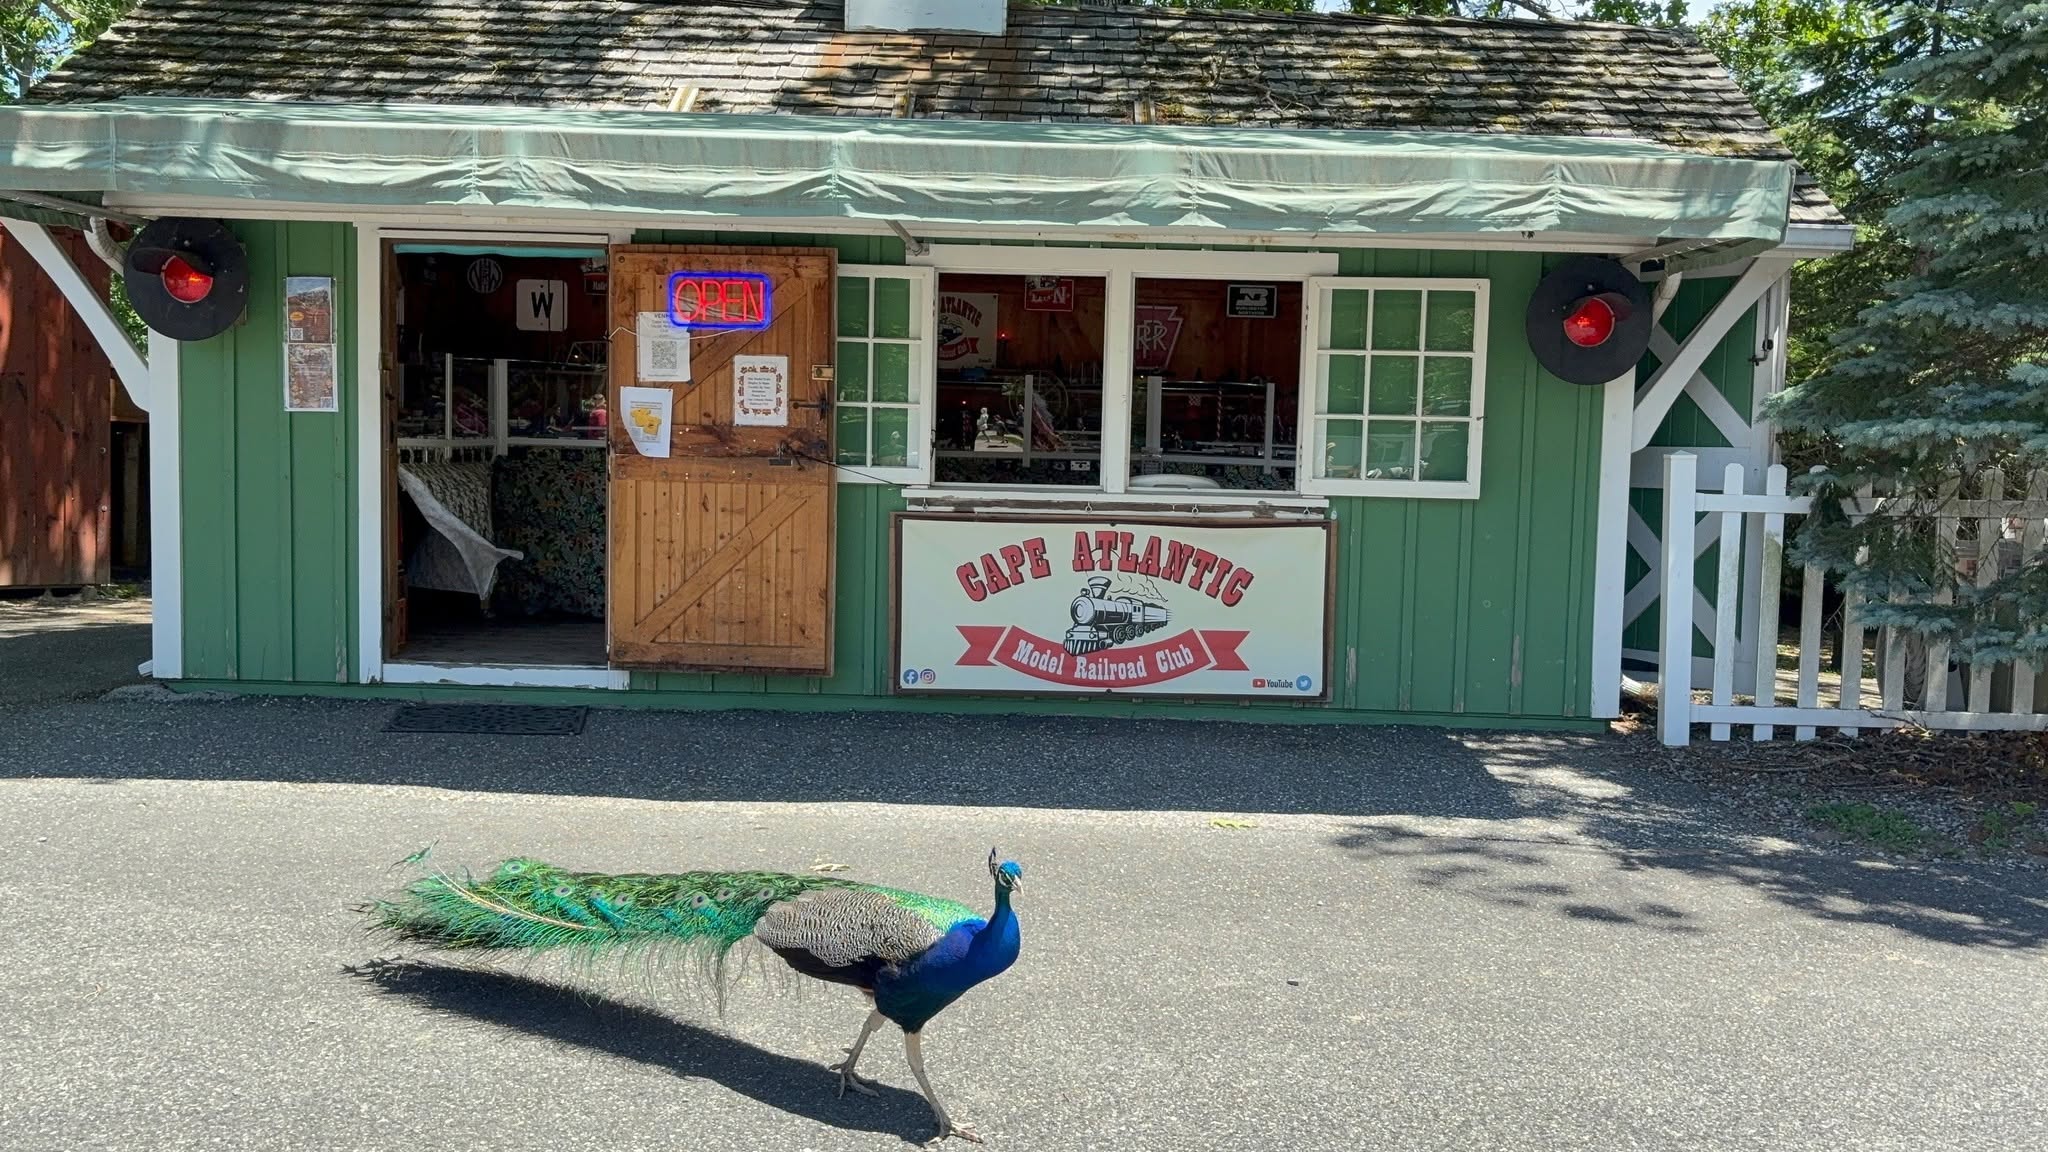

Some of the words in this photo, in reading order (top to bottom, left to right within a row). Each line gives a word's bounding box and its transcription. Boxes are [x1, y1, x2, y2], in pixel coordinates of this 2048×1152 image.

[531, 292, 554, 318] W
[675, 279, 764, 322] OPEN
[956, 537, 1051, 602] CAPE
[1072, 531, 1254, 607] ATLANTIC
[1012, 639, 1065, 675] Model
[1074, 655, 1147, 681] Railroad
[1155, 643, 1194, 673] Club
[1267, 679, 1293, 688] YouTube
